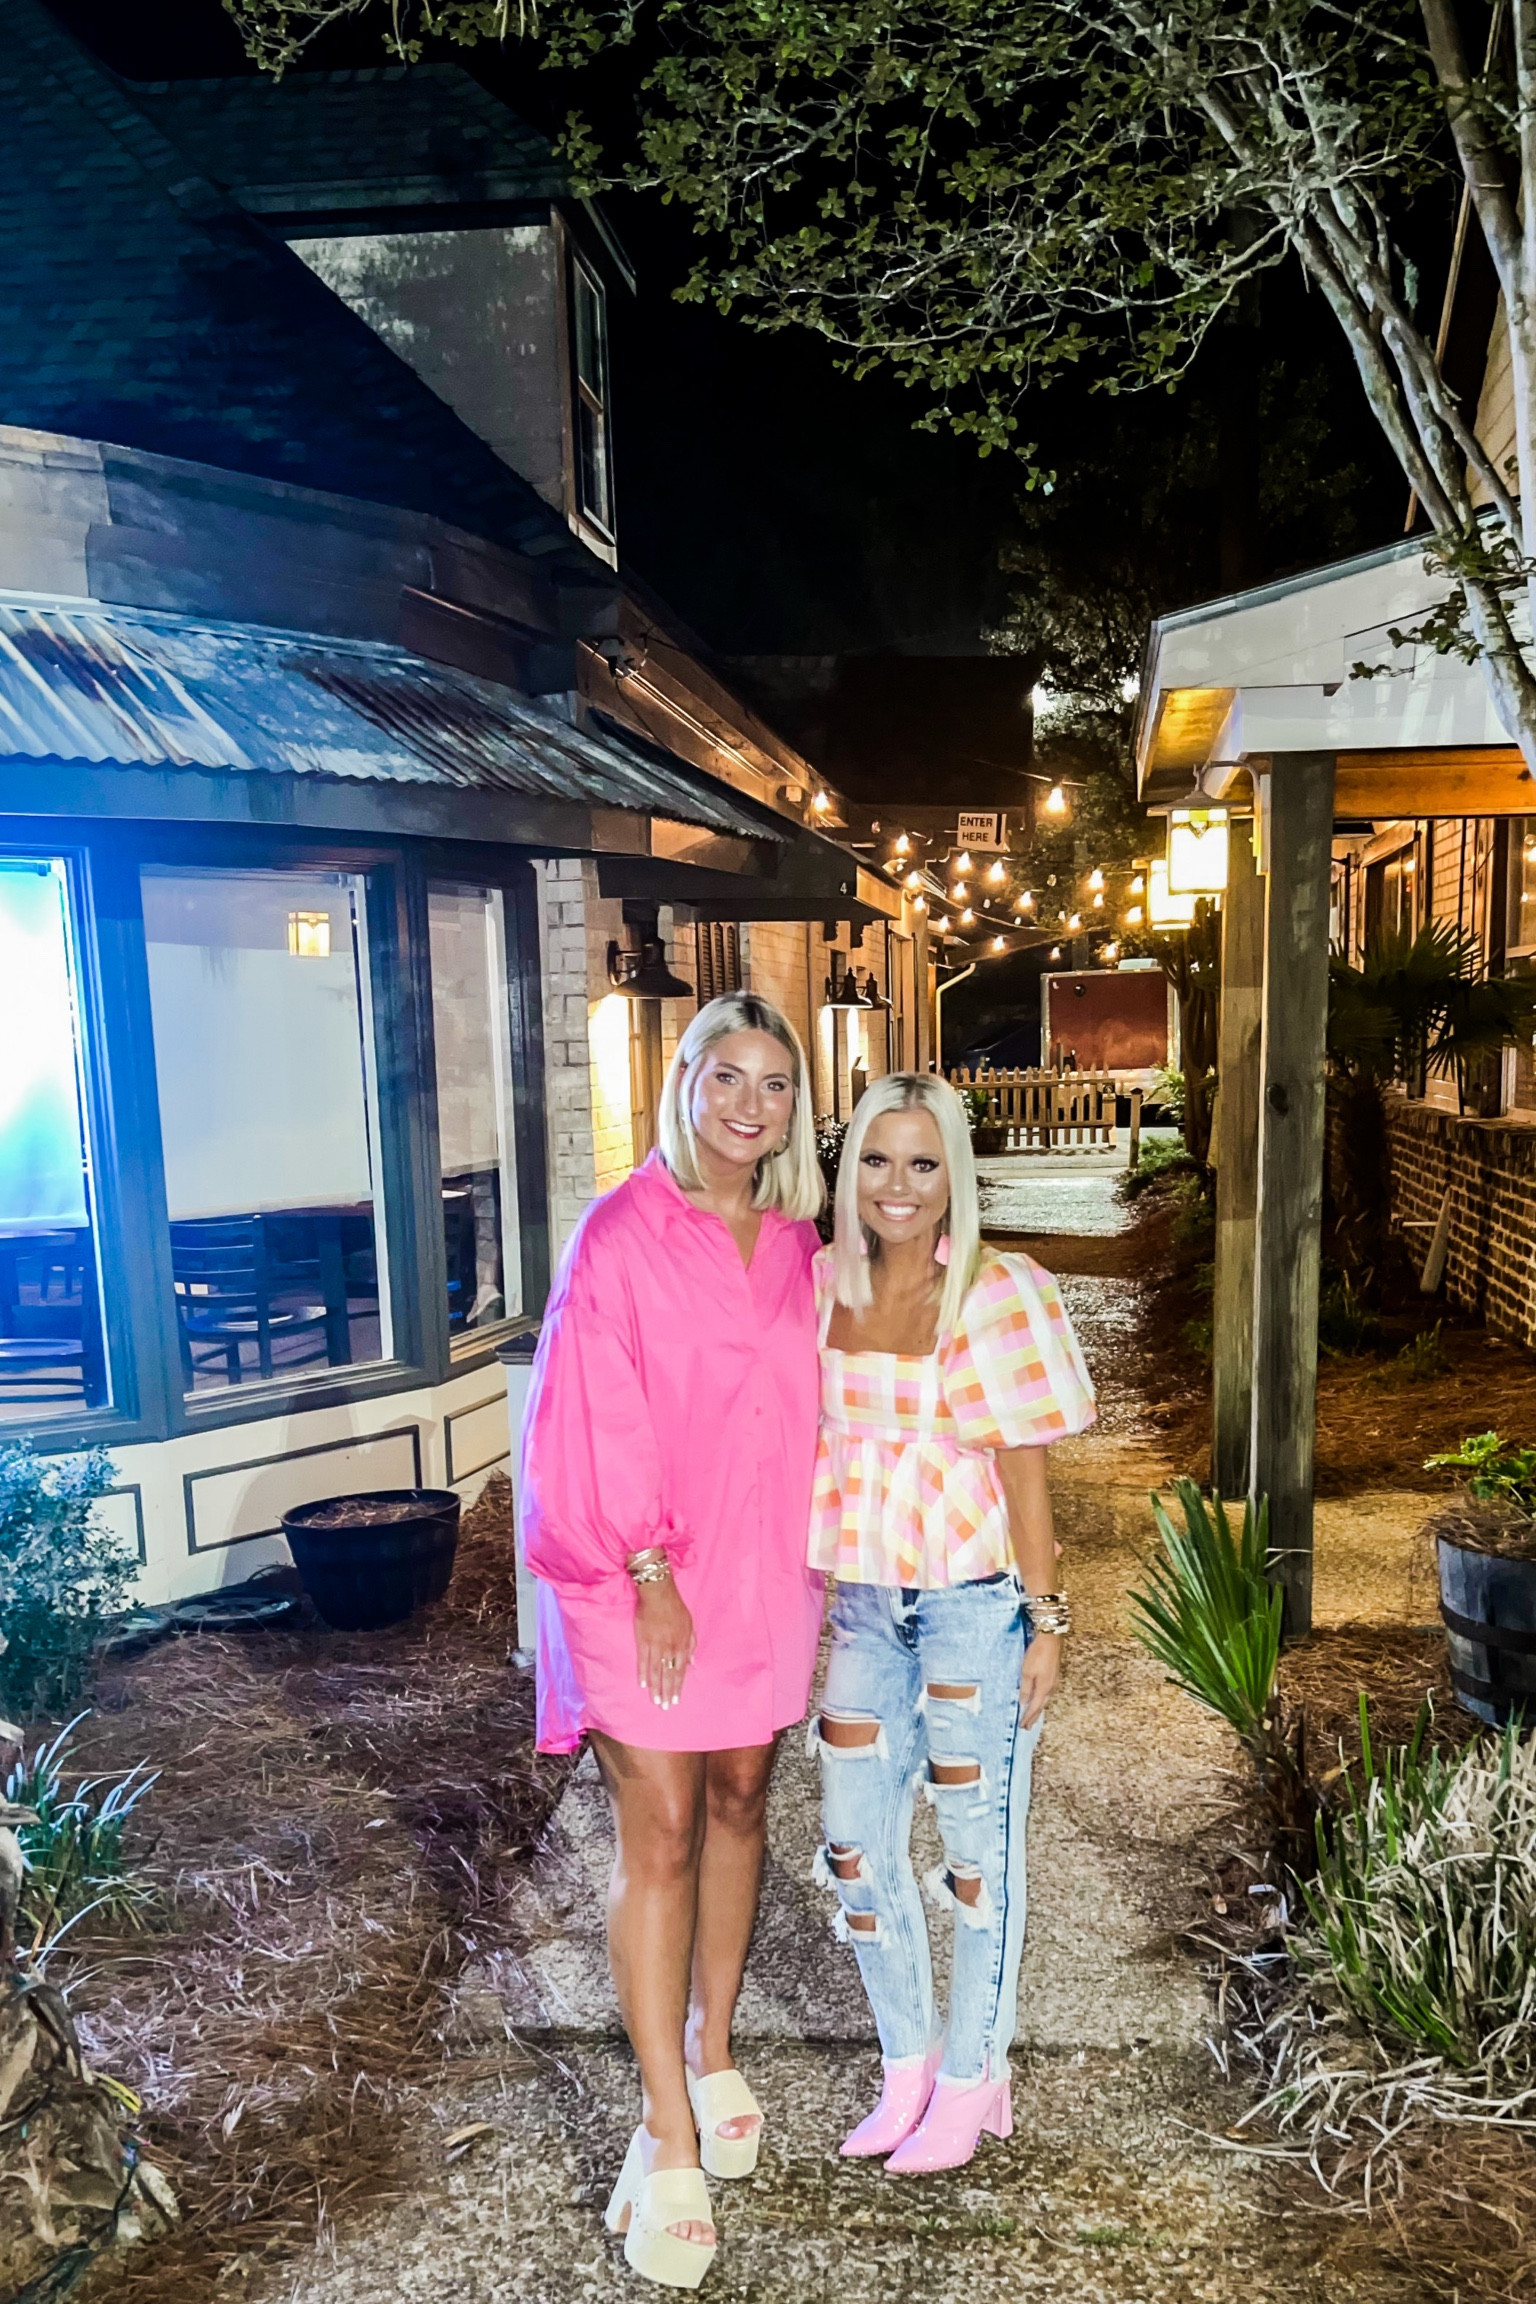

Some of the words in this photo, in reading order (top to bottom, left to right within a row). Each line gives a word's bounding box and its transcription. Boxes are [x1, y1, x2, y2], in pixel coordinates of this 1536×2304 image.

[960, 816, 993, 828] ENTER
[962, 832, 989, 842] HERE
[840, 882, 848, 895] 4
